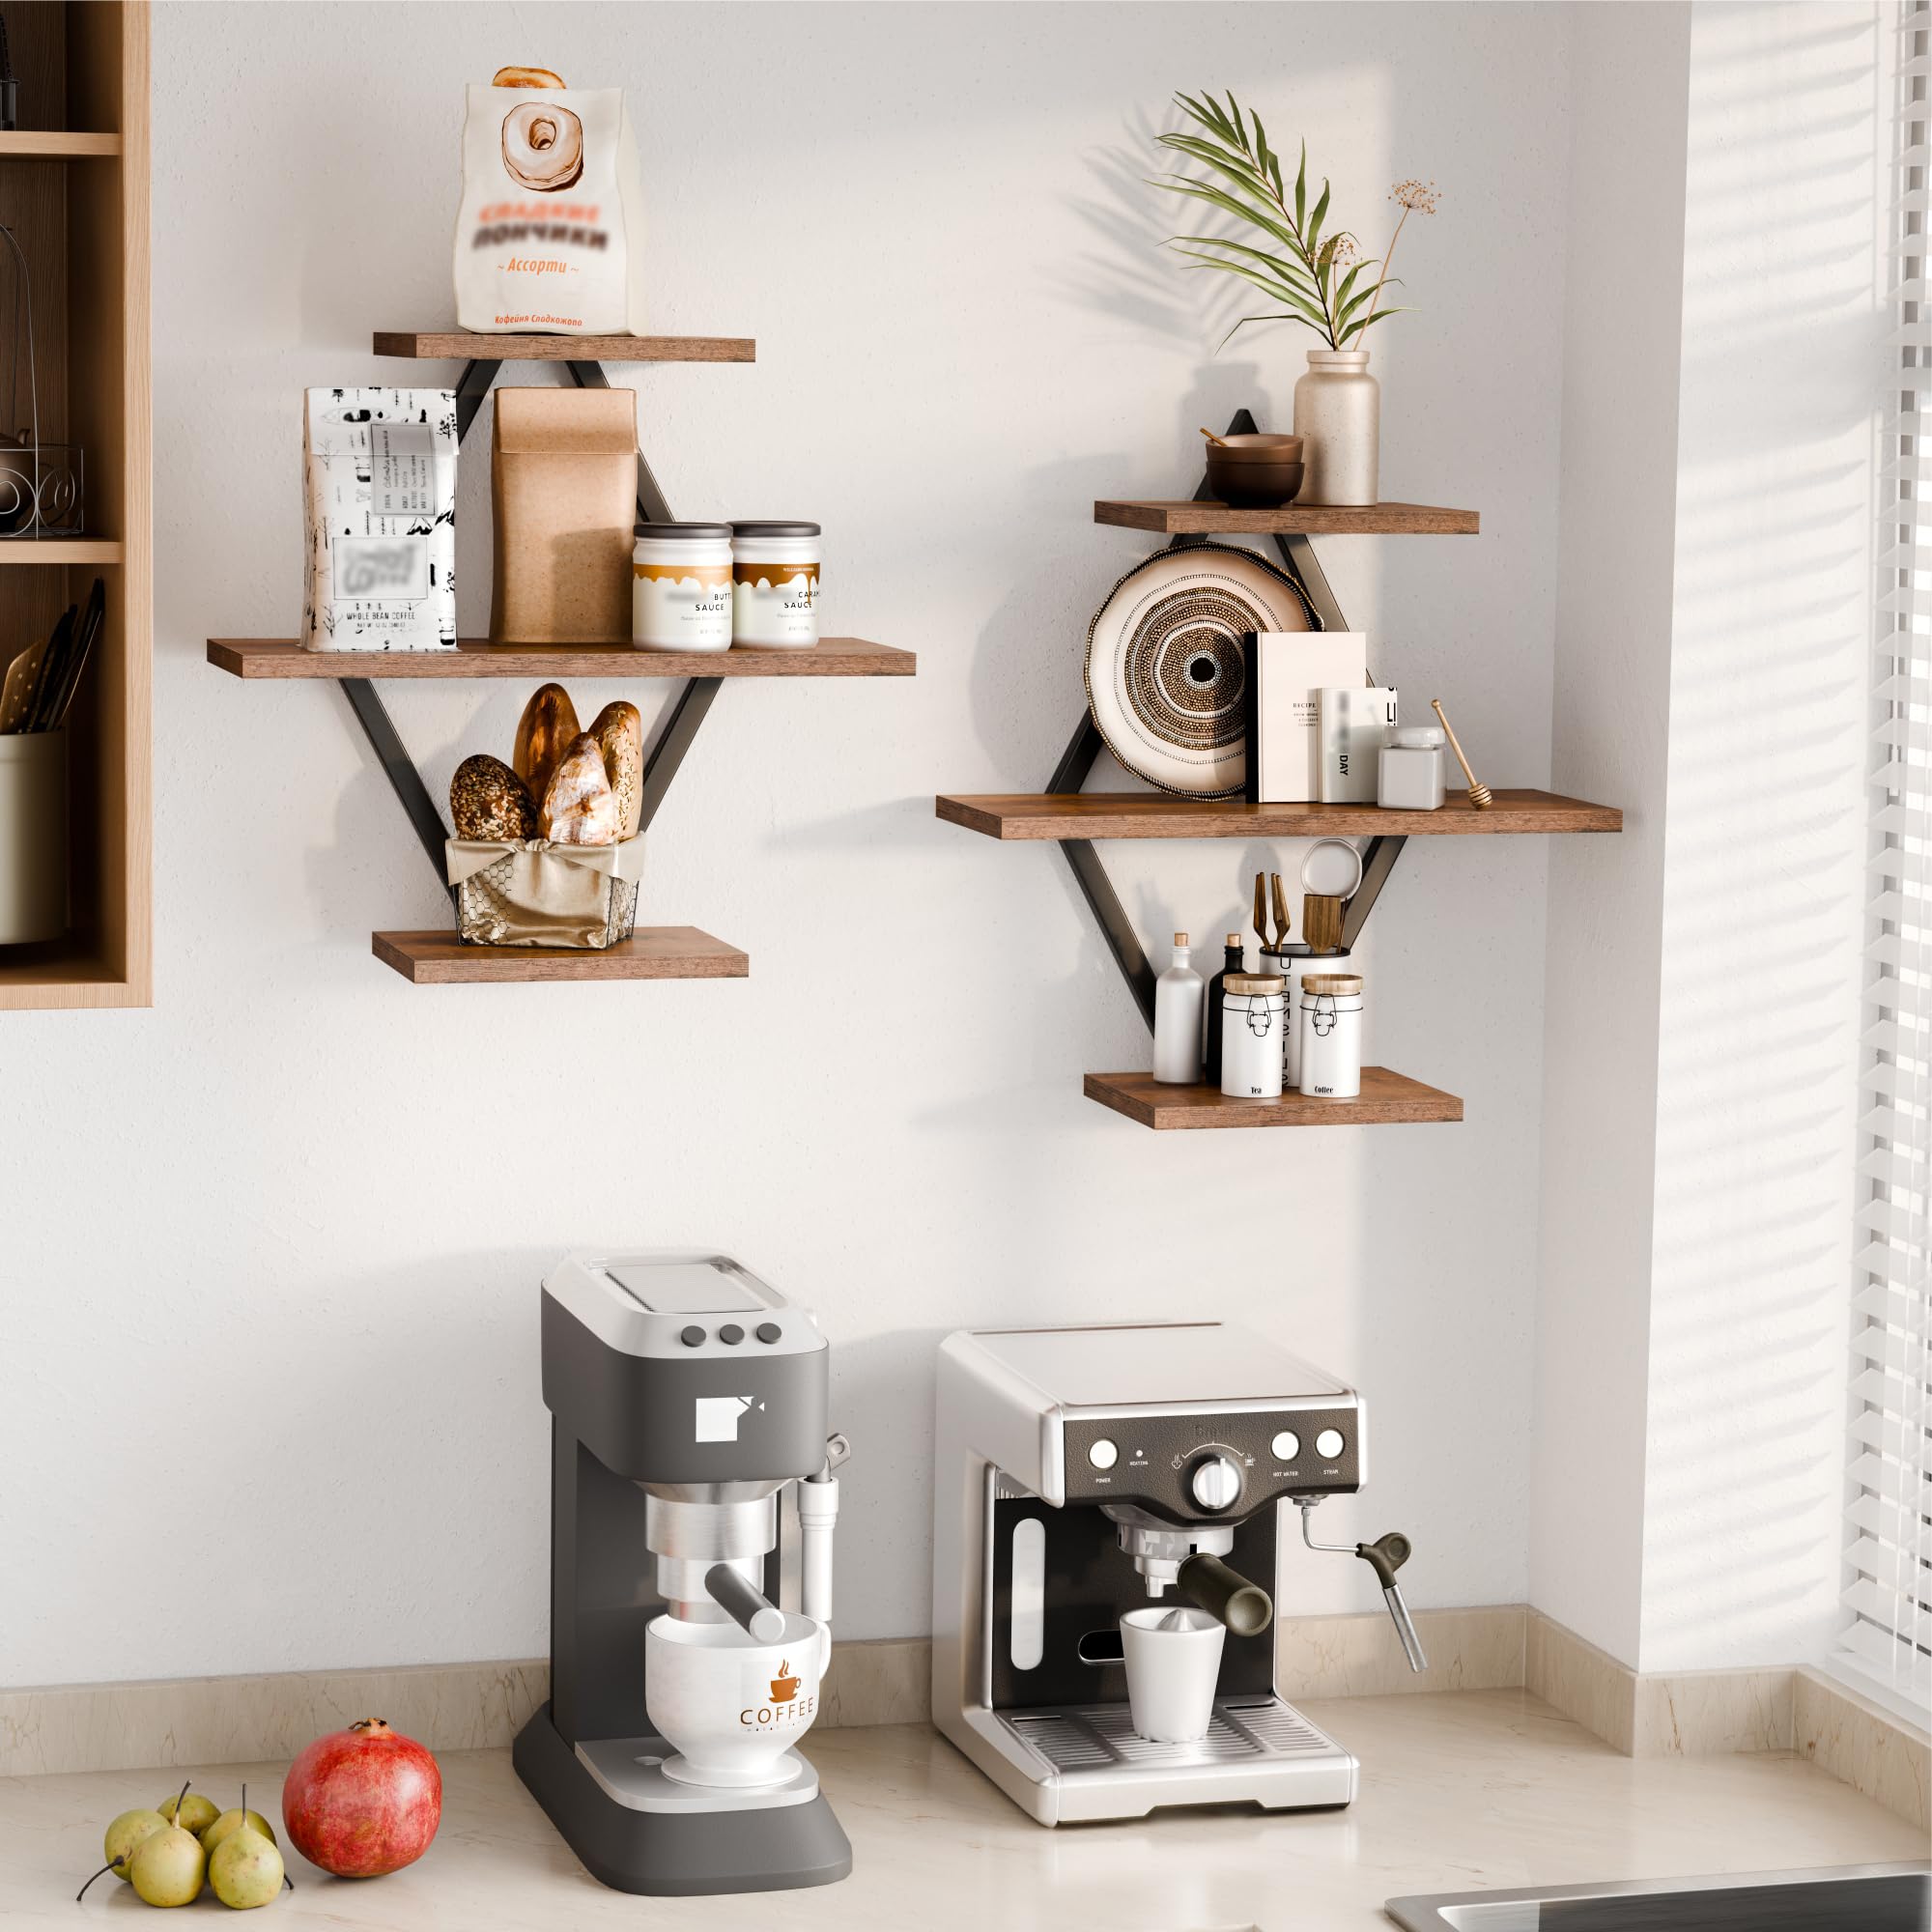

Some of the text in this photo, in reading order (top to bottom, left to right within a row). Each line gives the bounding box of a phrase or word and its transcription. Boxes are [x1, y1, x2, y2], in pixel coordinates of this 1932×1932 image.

[507, 257, 567, 275] Ассорти
[495, 314, 529, 325] Кофейня
[1339, 754, 1349, 776] DAY
[1314, 1085, 1334, 1094] Coffee
[740, 1696, 813, 1725] COFFEE
